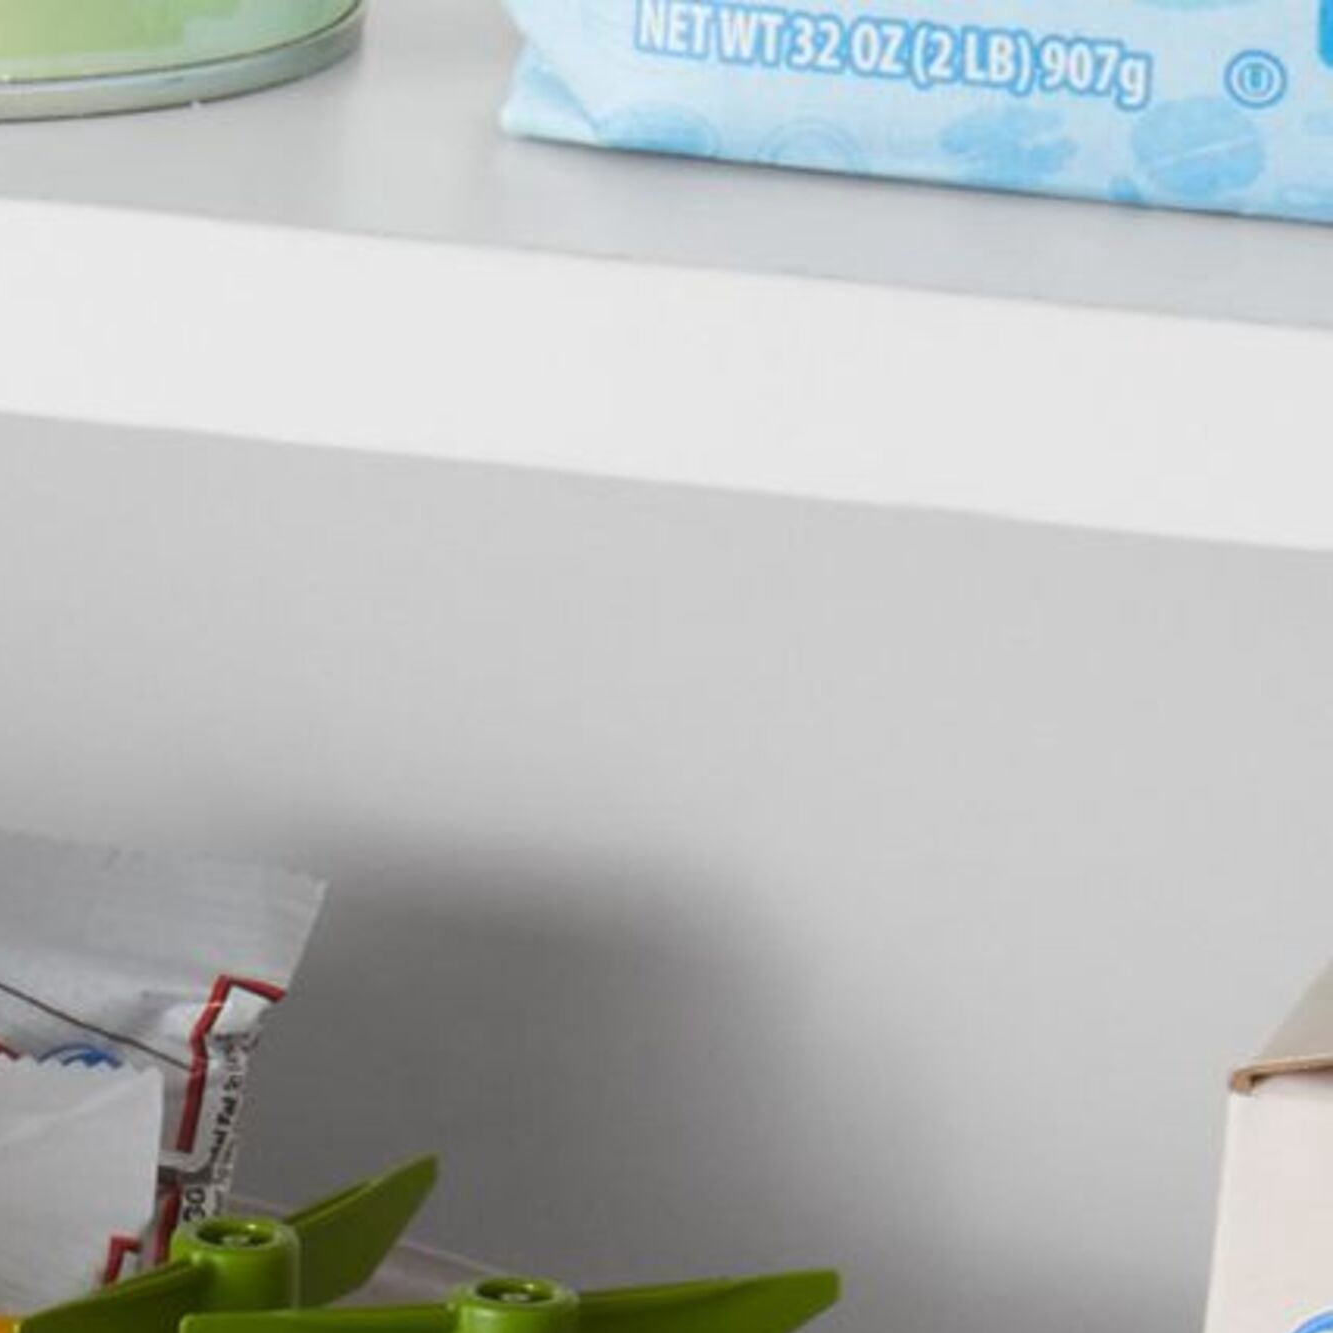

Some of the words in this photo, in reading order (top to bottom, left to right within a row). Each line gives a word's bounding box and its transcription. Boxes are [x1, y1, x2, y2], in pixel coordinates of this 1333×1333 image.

[636, 0, 711, 57] NET
[718, 6, 784, 66] WT
[787, 13, 844, 72] 32
[849, 20, 909, 77] OZ
[912, 23, 956, 88] (2
[961, 27, 1033, 95] LB)
[1037, 36, 1151, 110] 907g
